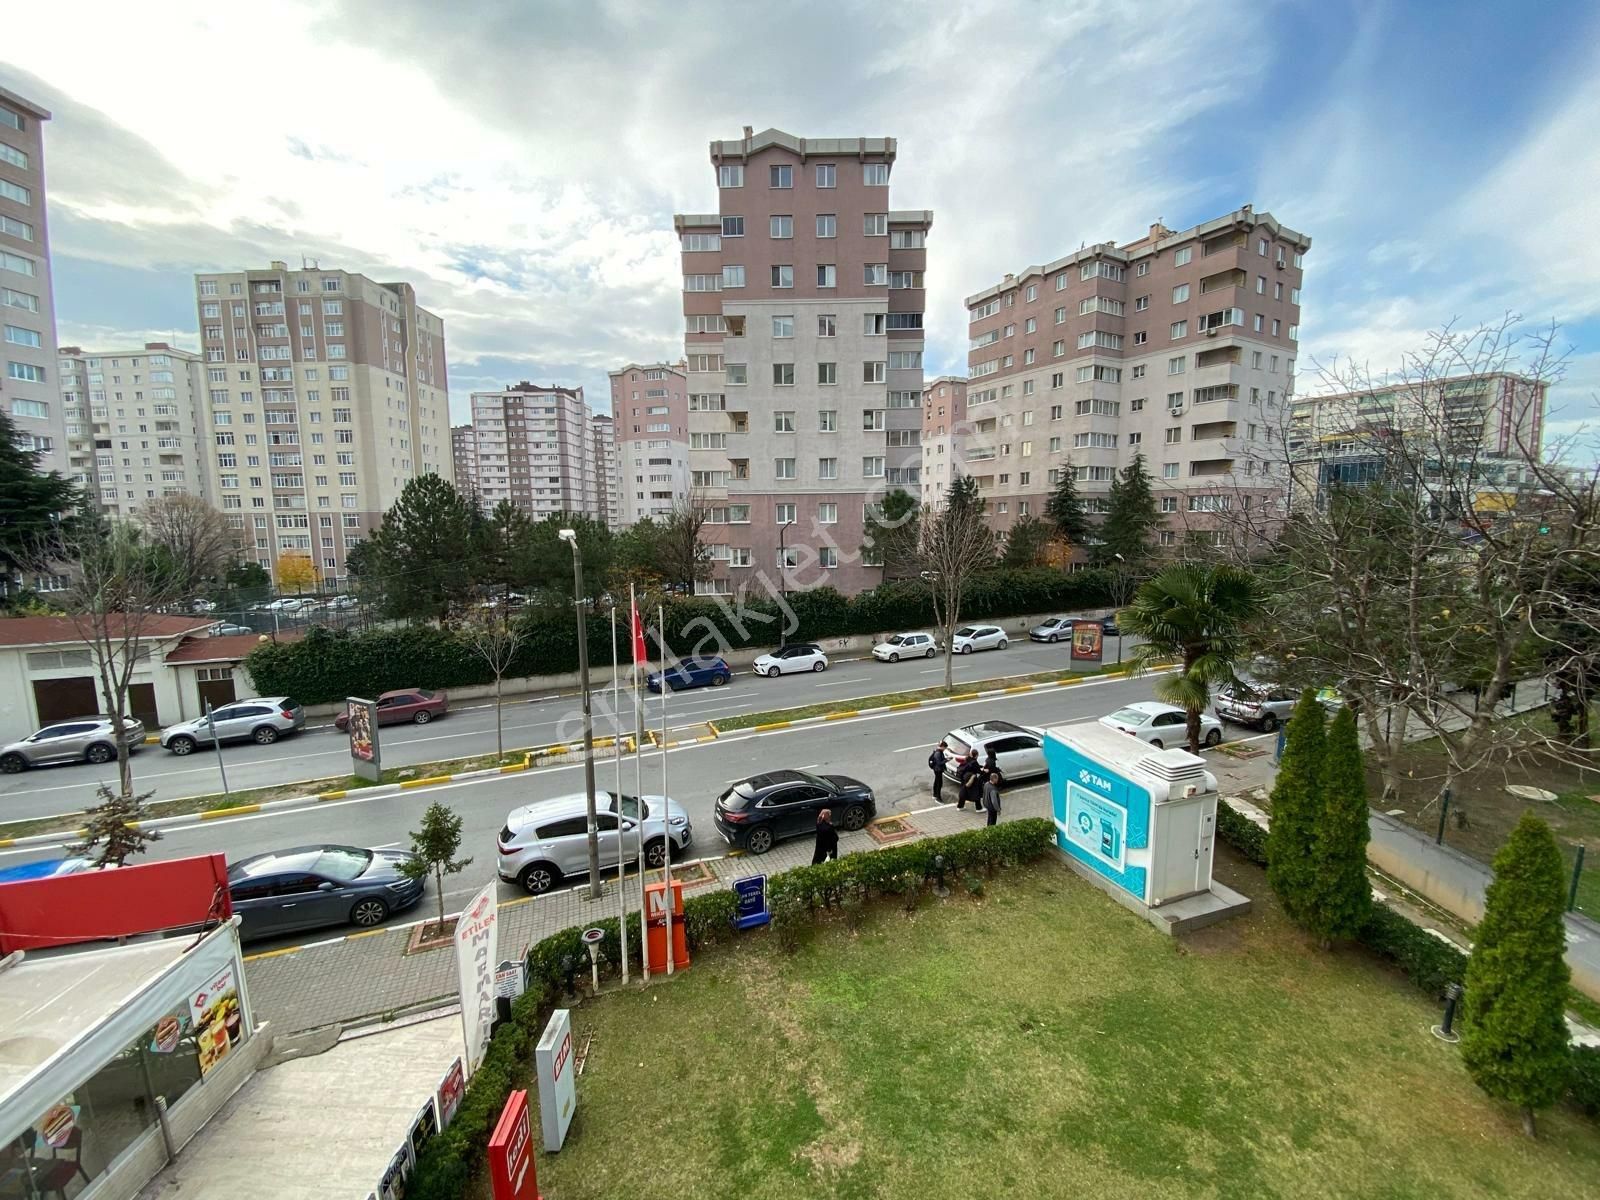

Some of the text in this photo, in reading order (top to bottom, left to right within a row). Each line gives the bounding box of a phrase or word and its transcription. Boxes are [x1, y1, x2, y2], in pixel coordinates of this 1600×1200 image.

[1091, 774, 1111, 792] TAM
[649, 887, 675, 913] M
[461, 913, 495, 939] ETİLER
